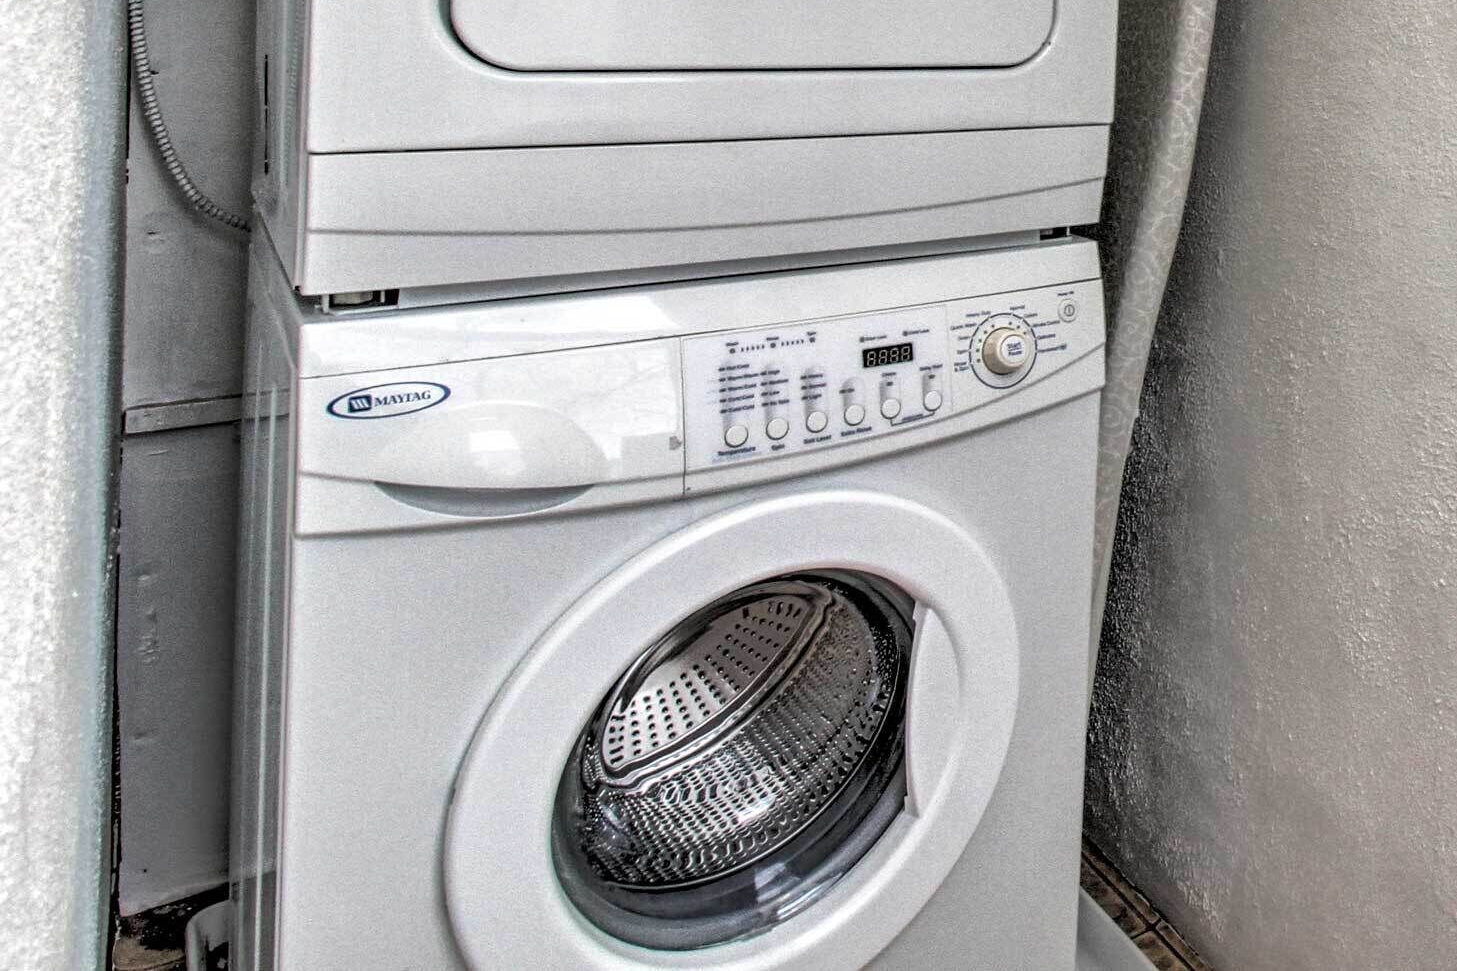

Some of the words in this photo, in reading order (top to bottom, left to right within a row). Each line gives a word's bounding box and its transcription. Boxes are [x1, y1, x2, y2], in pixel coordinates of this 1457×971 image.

[1007, 341, 1021, 350] Start
[374, 389, 432, 407] MAYTAG
[717, 445, 756, 457] Temperature
